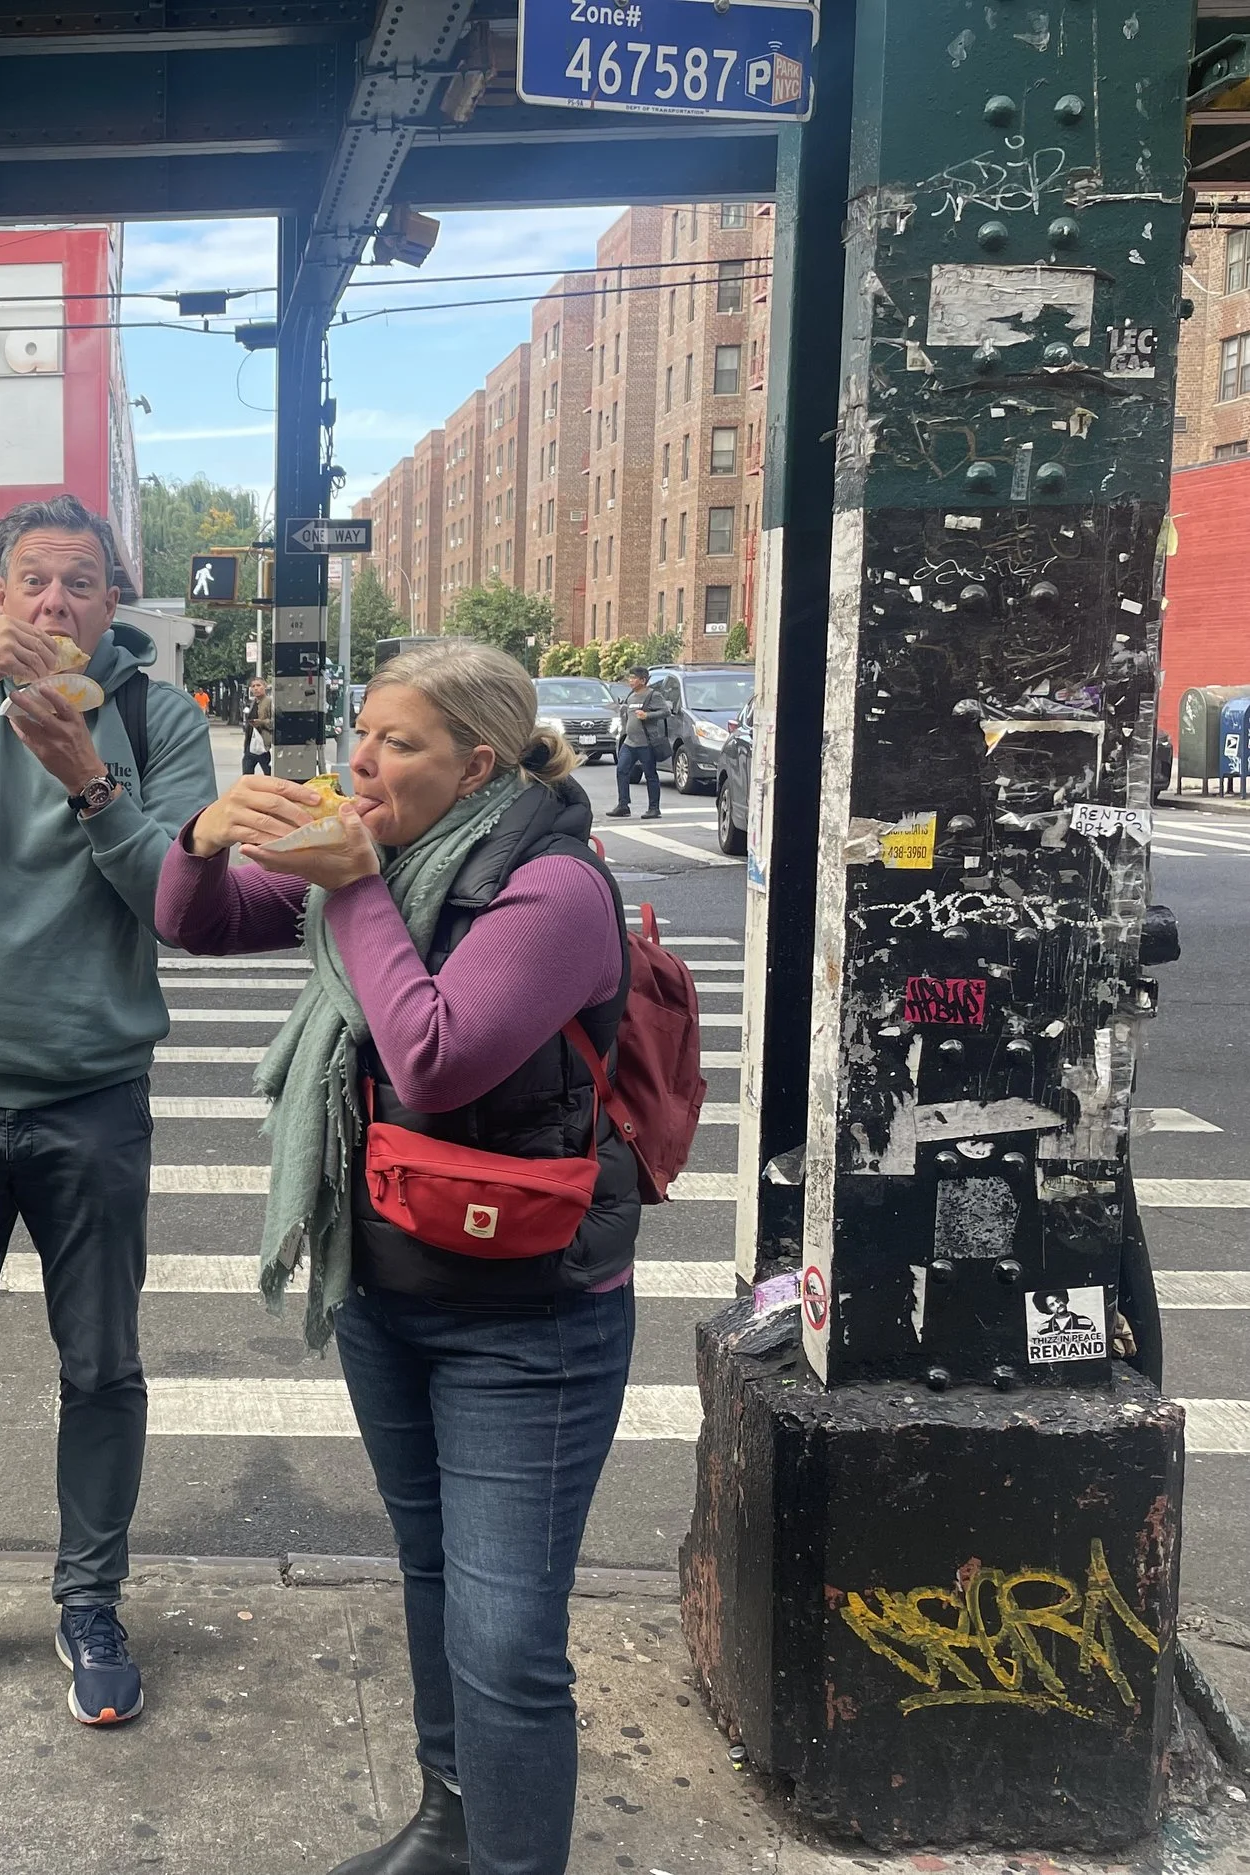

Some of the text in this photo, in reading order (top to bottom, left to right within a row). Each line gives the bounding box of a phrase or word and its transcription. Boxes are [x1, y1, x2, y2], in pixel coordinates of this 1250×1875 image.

[570, 0, 641, 28] Zone#
[565, 37, 738, 102] 467587
[776, 57, 800, 78] PARK
[775, 78, 800, 101] NYC
[651, 107, 705, 115] TRANSPORTATION
[301, 529, 362, 543] ONE WAY
[104, 762, 132, 777] The
[1080, 806, 1137, 822] RENTO
[1032, 1336, 1058, 1344] THIZZ
[1072, 1332, 1102, 1341] PEACE
[1030, 1341, 1104, 1359] REMAND
